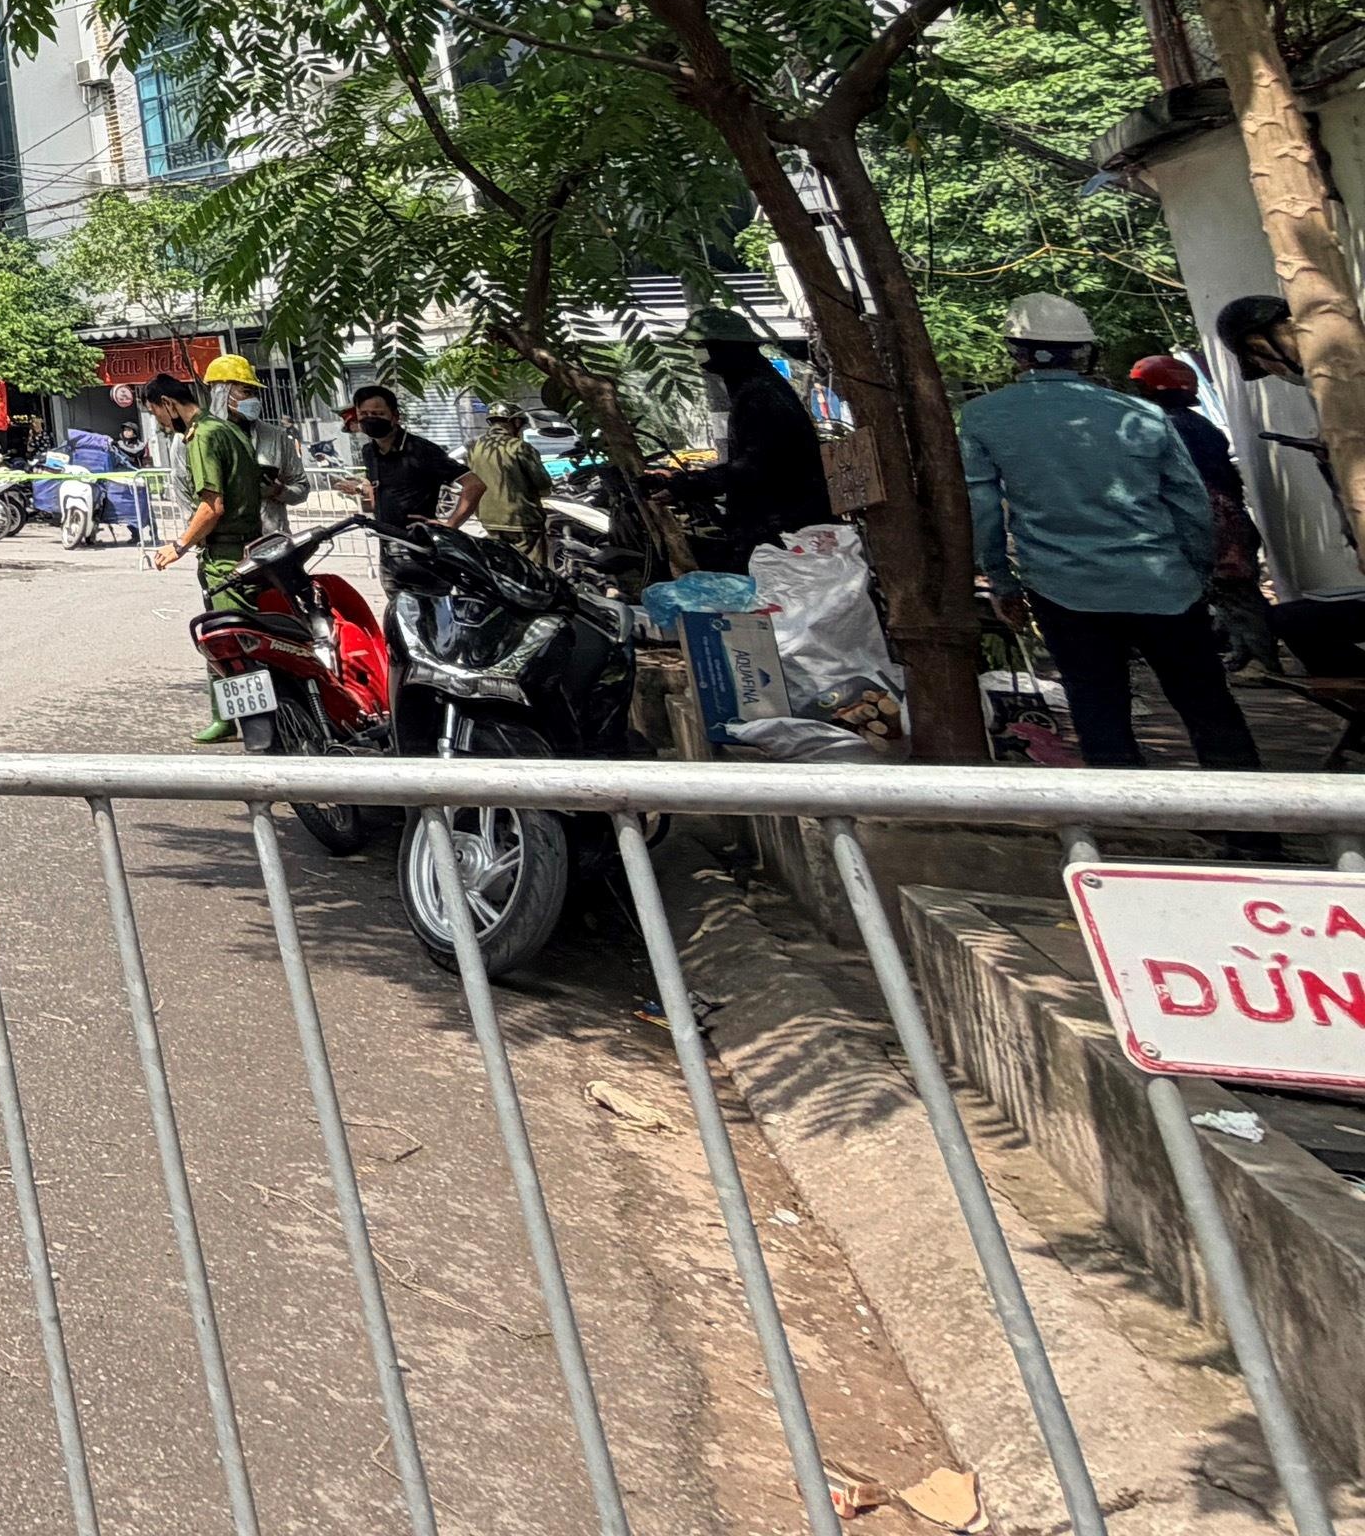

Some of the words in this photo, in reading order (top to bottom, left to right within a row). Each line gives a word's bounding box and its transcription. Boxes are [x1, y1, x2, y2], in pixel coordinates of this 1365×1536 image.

[222, 675, 263, 698] 86-F8
[733, 648, 759, 705] AQUAFINA
[226, 693, 267, 715] 8866
